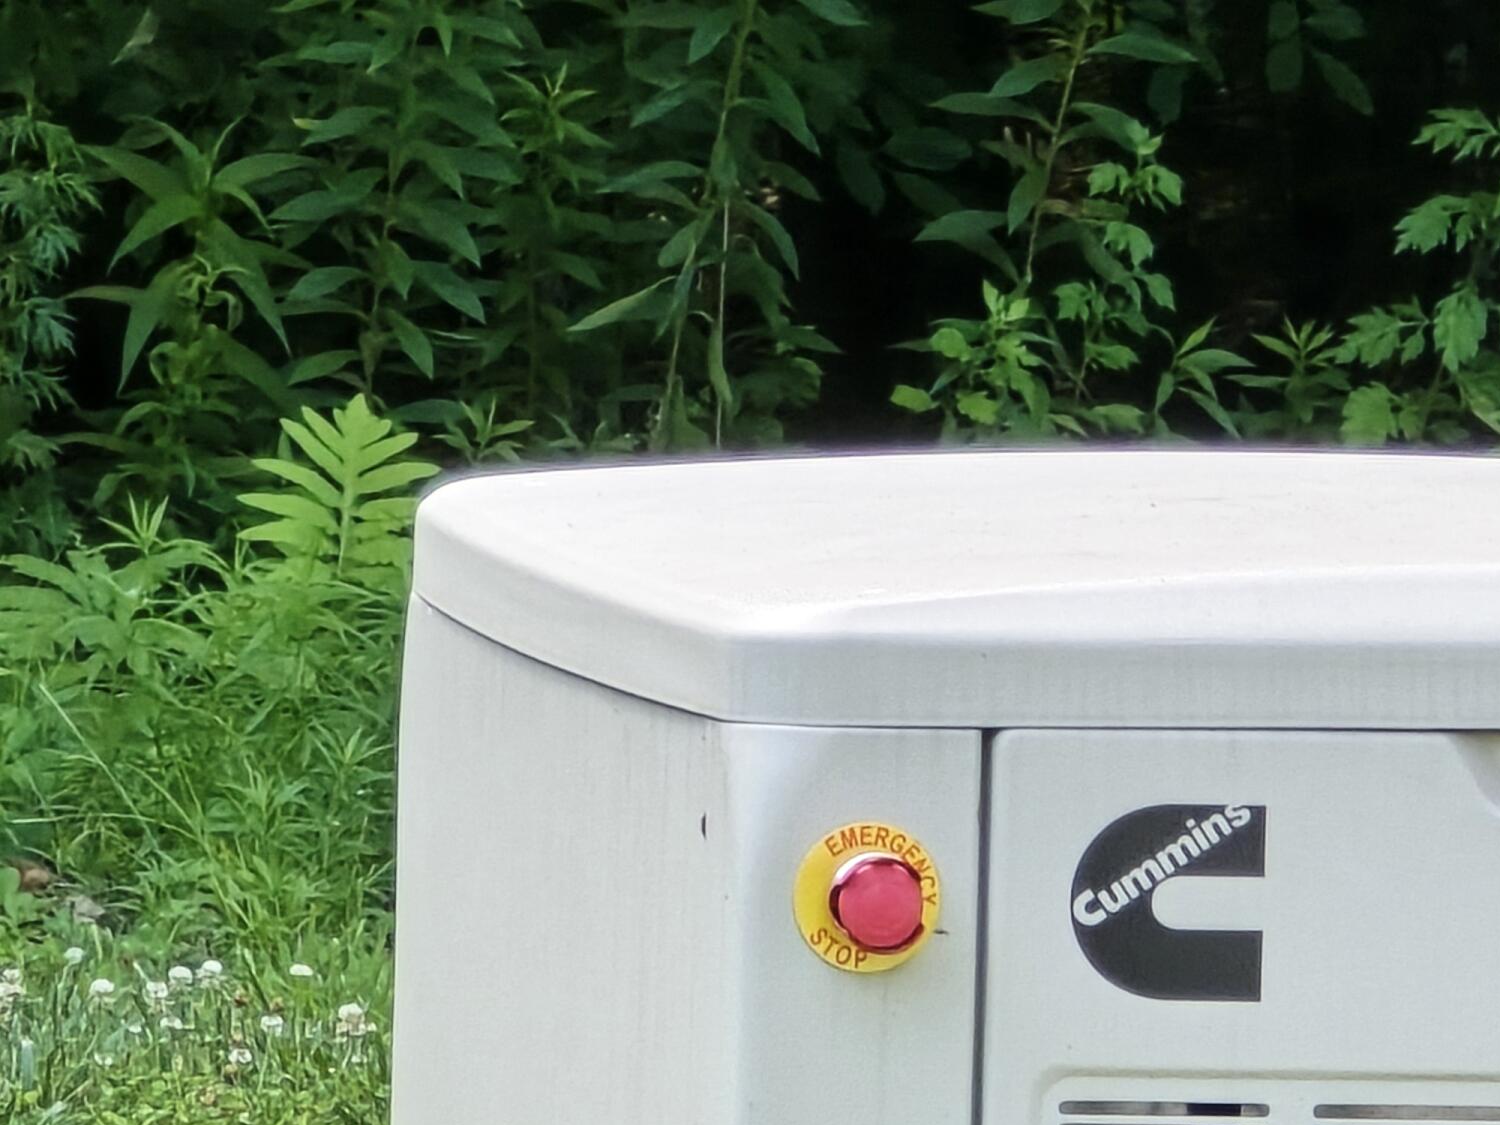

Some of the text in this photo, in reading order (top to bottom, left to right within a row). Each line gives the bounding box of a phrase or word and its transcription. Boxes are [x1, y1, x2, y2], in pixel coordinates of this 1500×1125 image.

[824, 825, 937, 906] EMERGENCY
[1073, 803, 1252, 927] Cummins
[809, 927, 868, 969] STOP
